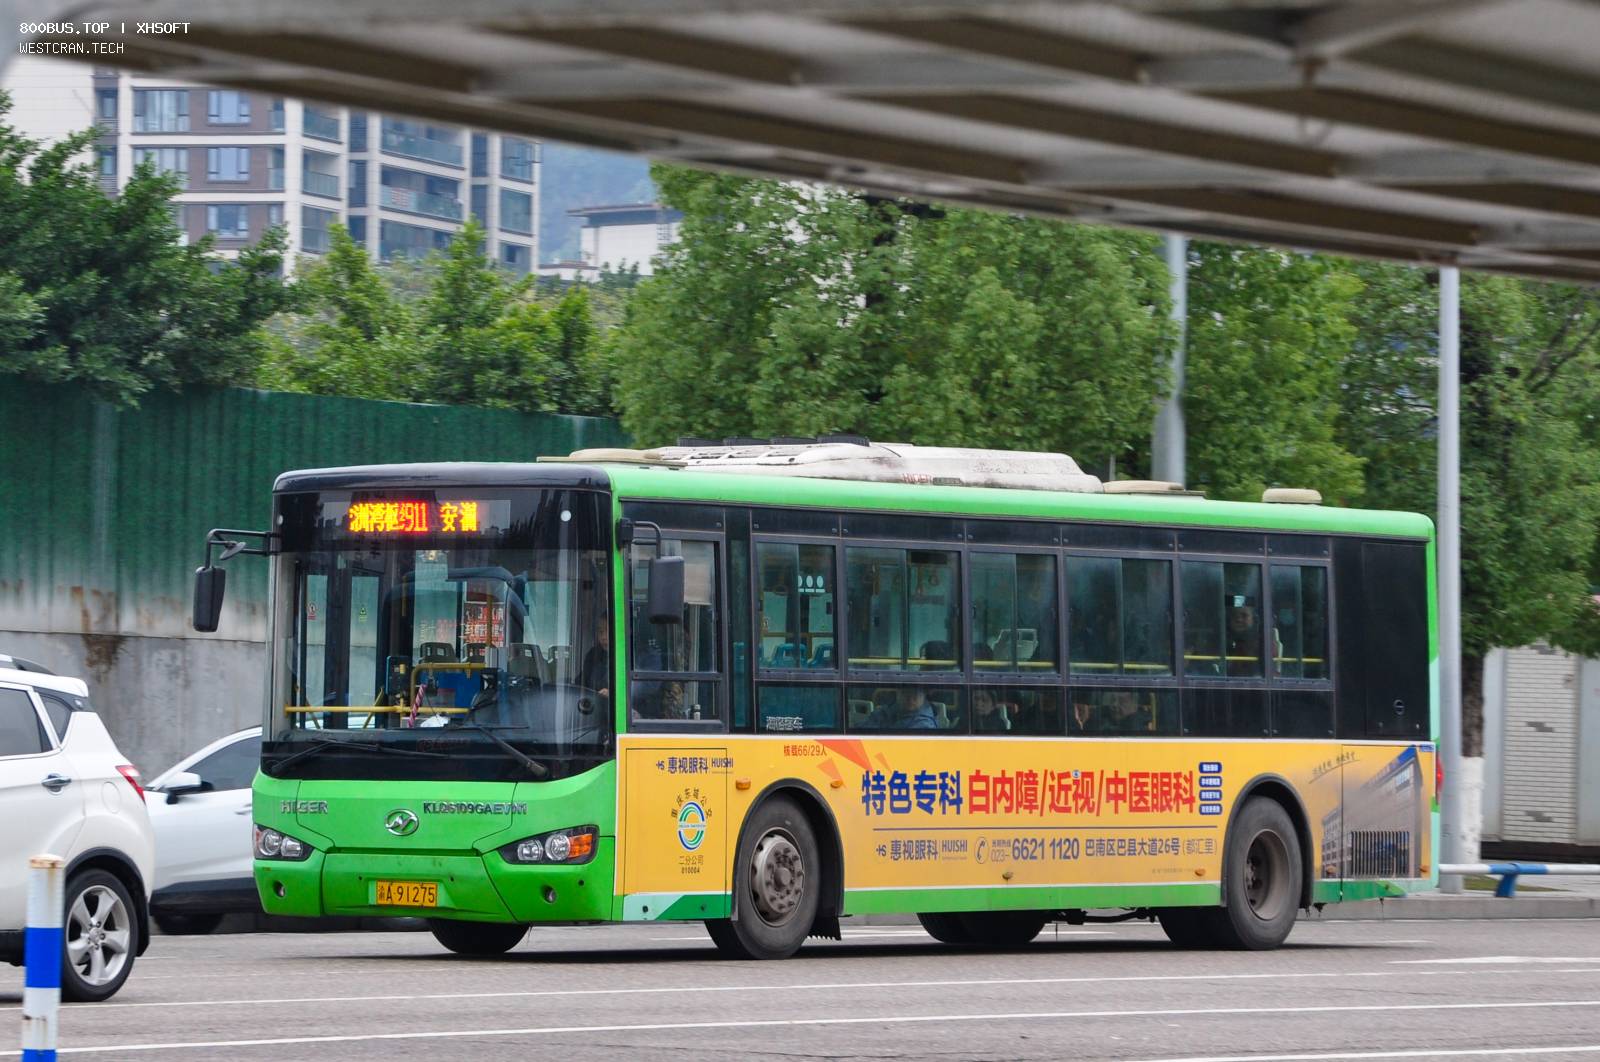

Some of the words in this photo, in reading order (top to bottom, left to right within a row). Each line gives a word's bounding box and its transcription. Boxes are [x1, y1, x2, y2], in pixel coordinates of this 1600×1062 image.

[667, 756, 708, 774] 惠视眼科
[711, 757, 734, 768] HUISHI
[861, 770, 963, 815] 特色专科
[968, 769, 1196, 817] 白内障/近视/中医眼科
[280, 800, 328, 815] HIGER
[890, 840, 939, 860] 惠视眼科
[941, 840, 968, 853] HUISHI
[1012, 838, 1046, 860] 6621
[1049, 837, 1080, 860] 1120
[1085, 837, 1181, 857] 巴南区巴县大道26号
[678, 854, 704, 866] 二分公司
